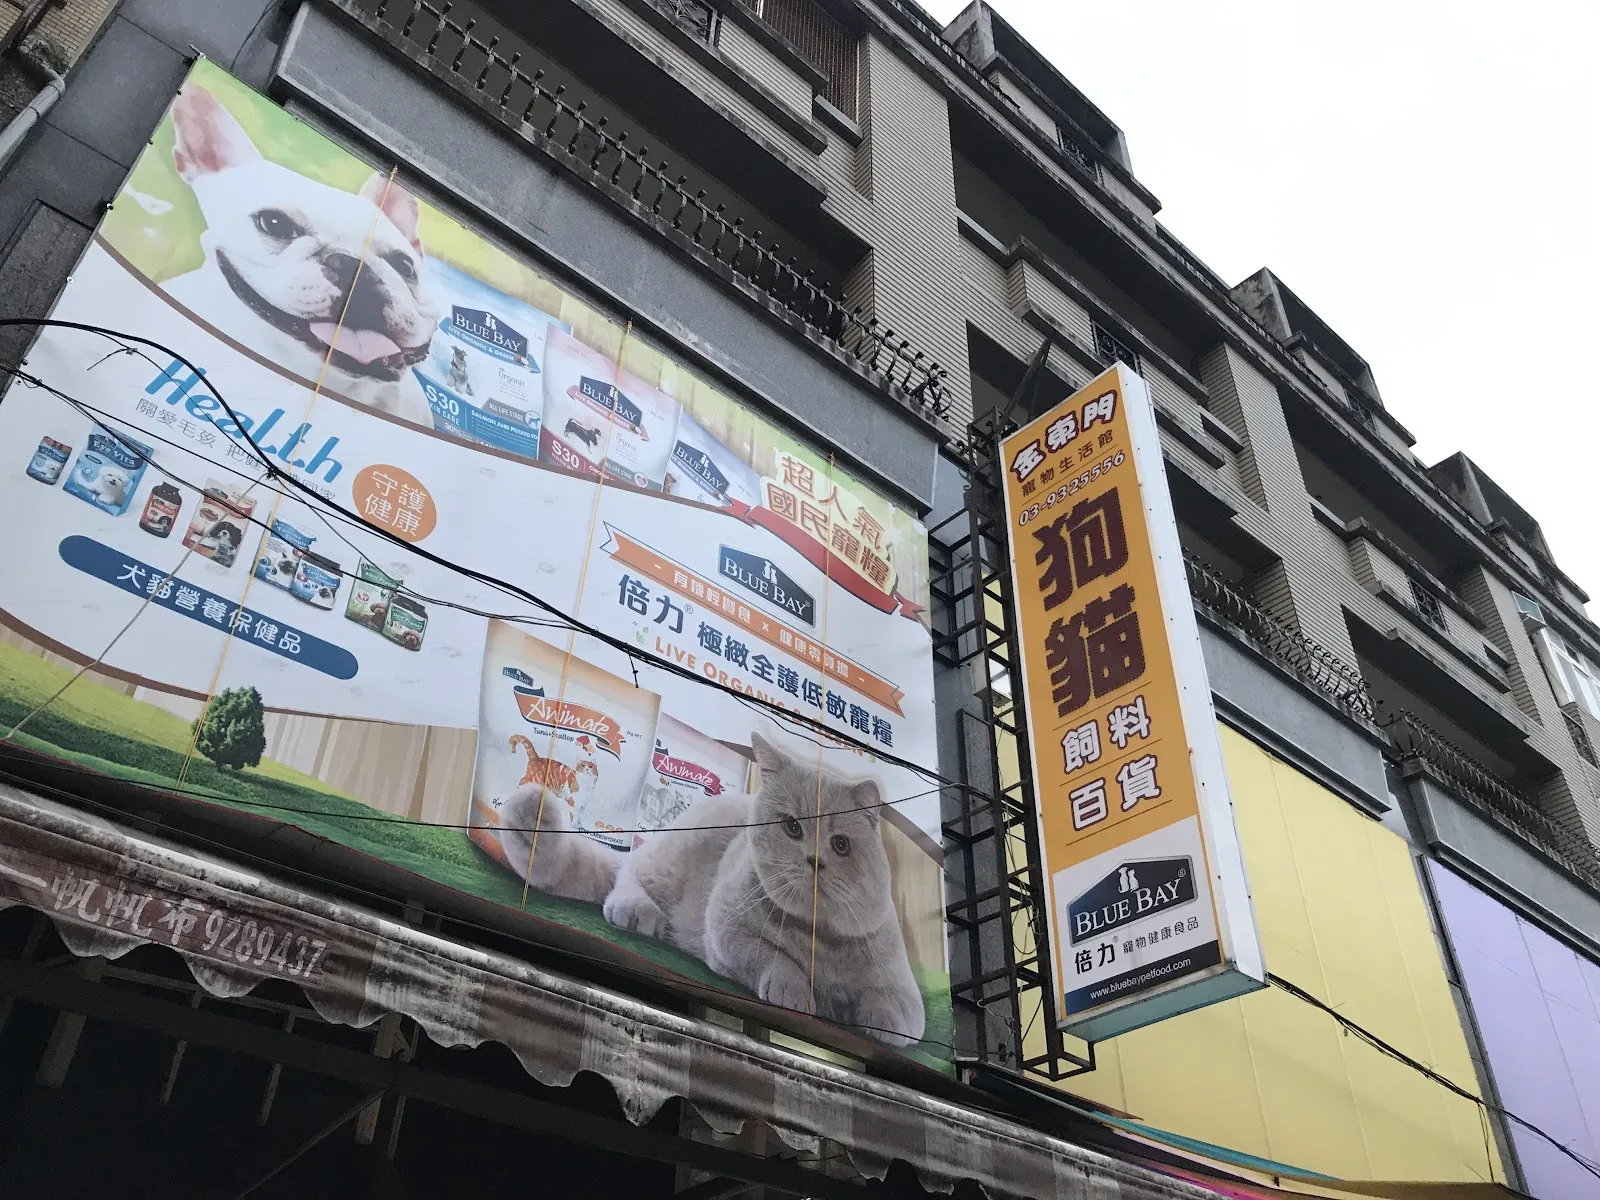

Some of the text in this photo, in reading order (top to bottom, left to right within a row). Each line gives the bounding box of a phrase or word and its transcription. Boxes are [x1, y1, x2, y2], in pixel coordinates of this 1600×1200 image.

[455, 313, 489, 339] BLUE
[494, 330, 520, 352] BAY
[135, 398, 217, 449] 關愛毛孩
[144, 358, 343, 484] Health
[425, 384, 460, 416] S30
[442, 410, 460, 426] CARE
[583, 383, 612, 408] BLUE
[615, 402, 636, 422] BAY
[552, 440, 580, 469] S30
[1010, 389, 1117, 483] 金東門
[1022, 429, 1113, 497] 寵物生活館
[372, 470, 427, 515] 守護
[676, 446, 723, 489] BLUE BAY
[1018, 450, 1125, 526] 03-9325556
[364, 493, 421, 537] 健康
[781, 455, 885, 550] 超人氣
[767, 483, 889, 589] 國民寵糧
[116, 563, 302, 655] 犬貓營養保健品
[724, 556, 806, 617] BLUE BAY
[655, 636, 696, 670] LIVE
[697, 620, 893, 748] 極緻全護低敏寵糧
[527, 697, 610, 736] Animate
[1061, 695, 1151, 774] 飼料
[656, 755, 713, 786] Animate
[1069, 753, 1162, 831] 百貨
[1074, 877, 1181, 937] BLUE BAY
[202, 908, 327, 978] 9289437
[1074, 916, 1199, 975] 倍力 寵物健康食品
[1089, 958, 1191, 1000] www.bluebaypetfood.com
